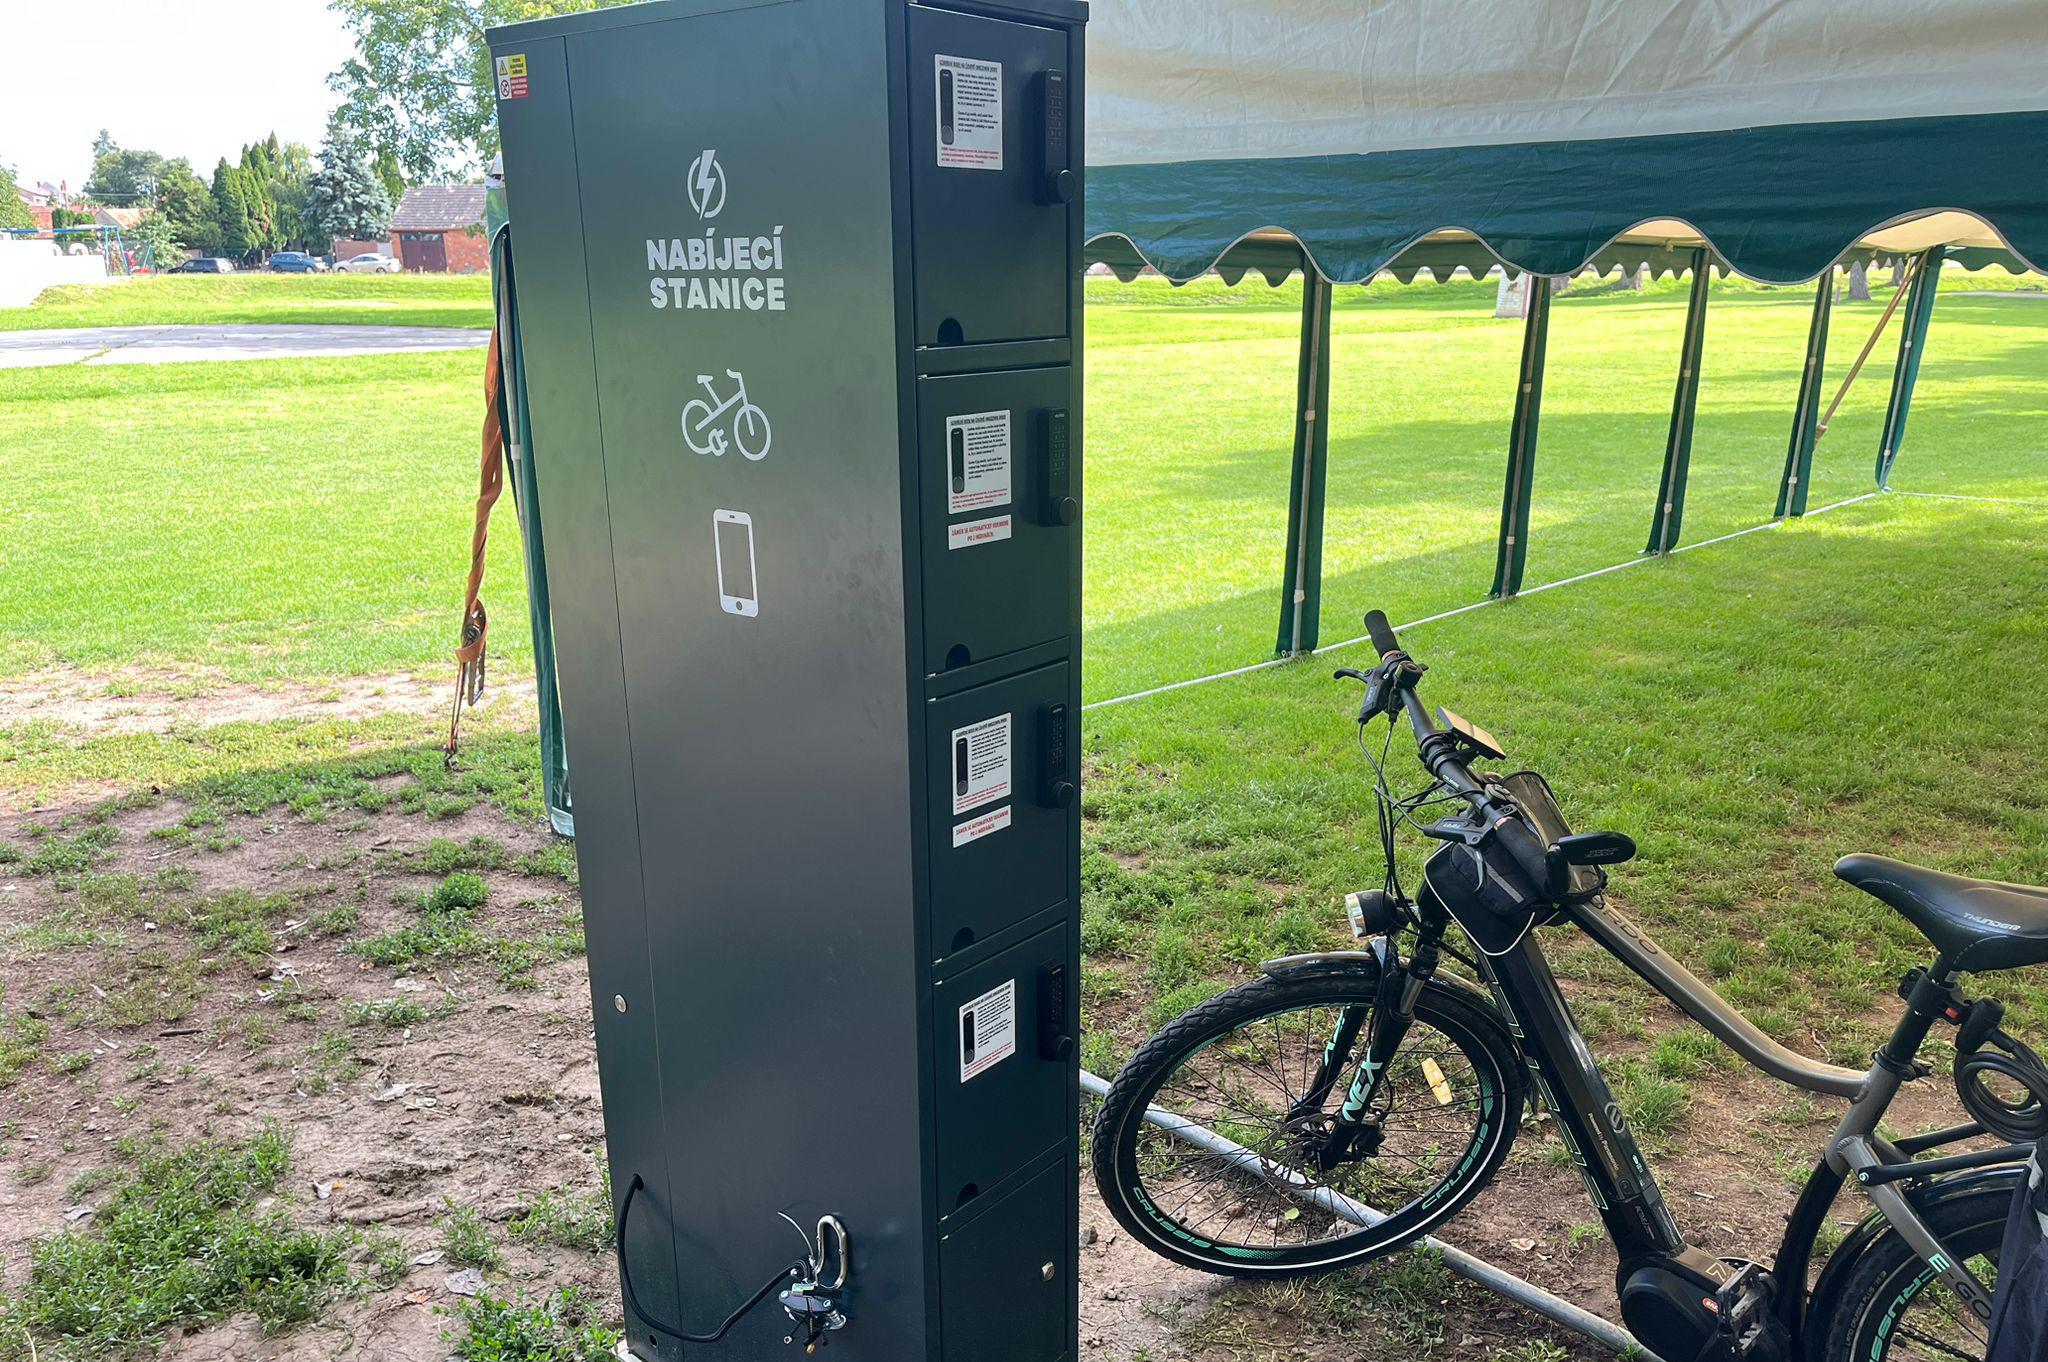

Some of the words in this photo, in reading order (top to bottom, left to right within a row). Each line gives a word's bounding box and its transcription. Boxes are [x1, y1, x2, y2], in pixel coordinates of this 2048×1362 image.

[646, 225, 784, 270] NABÍJECÍ
[650, 277, 786, 311] STANICE
[1602, 910, 1658, 955] RDO
[1601, 1140, 1620, 1171] Panasonic
[1132, 1186, 1212, 1248] CRUSSIS
[1928, 1253, 1993, 1320] E-GO
[1869, 1267, 1936, 1362] CRUSS
